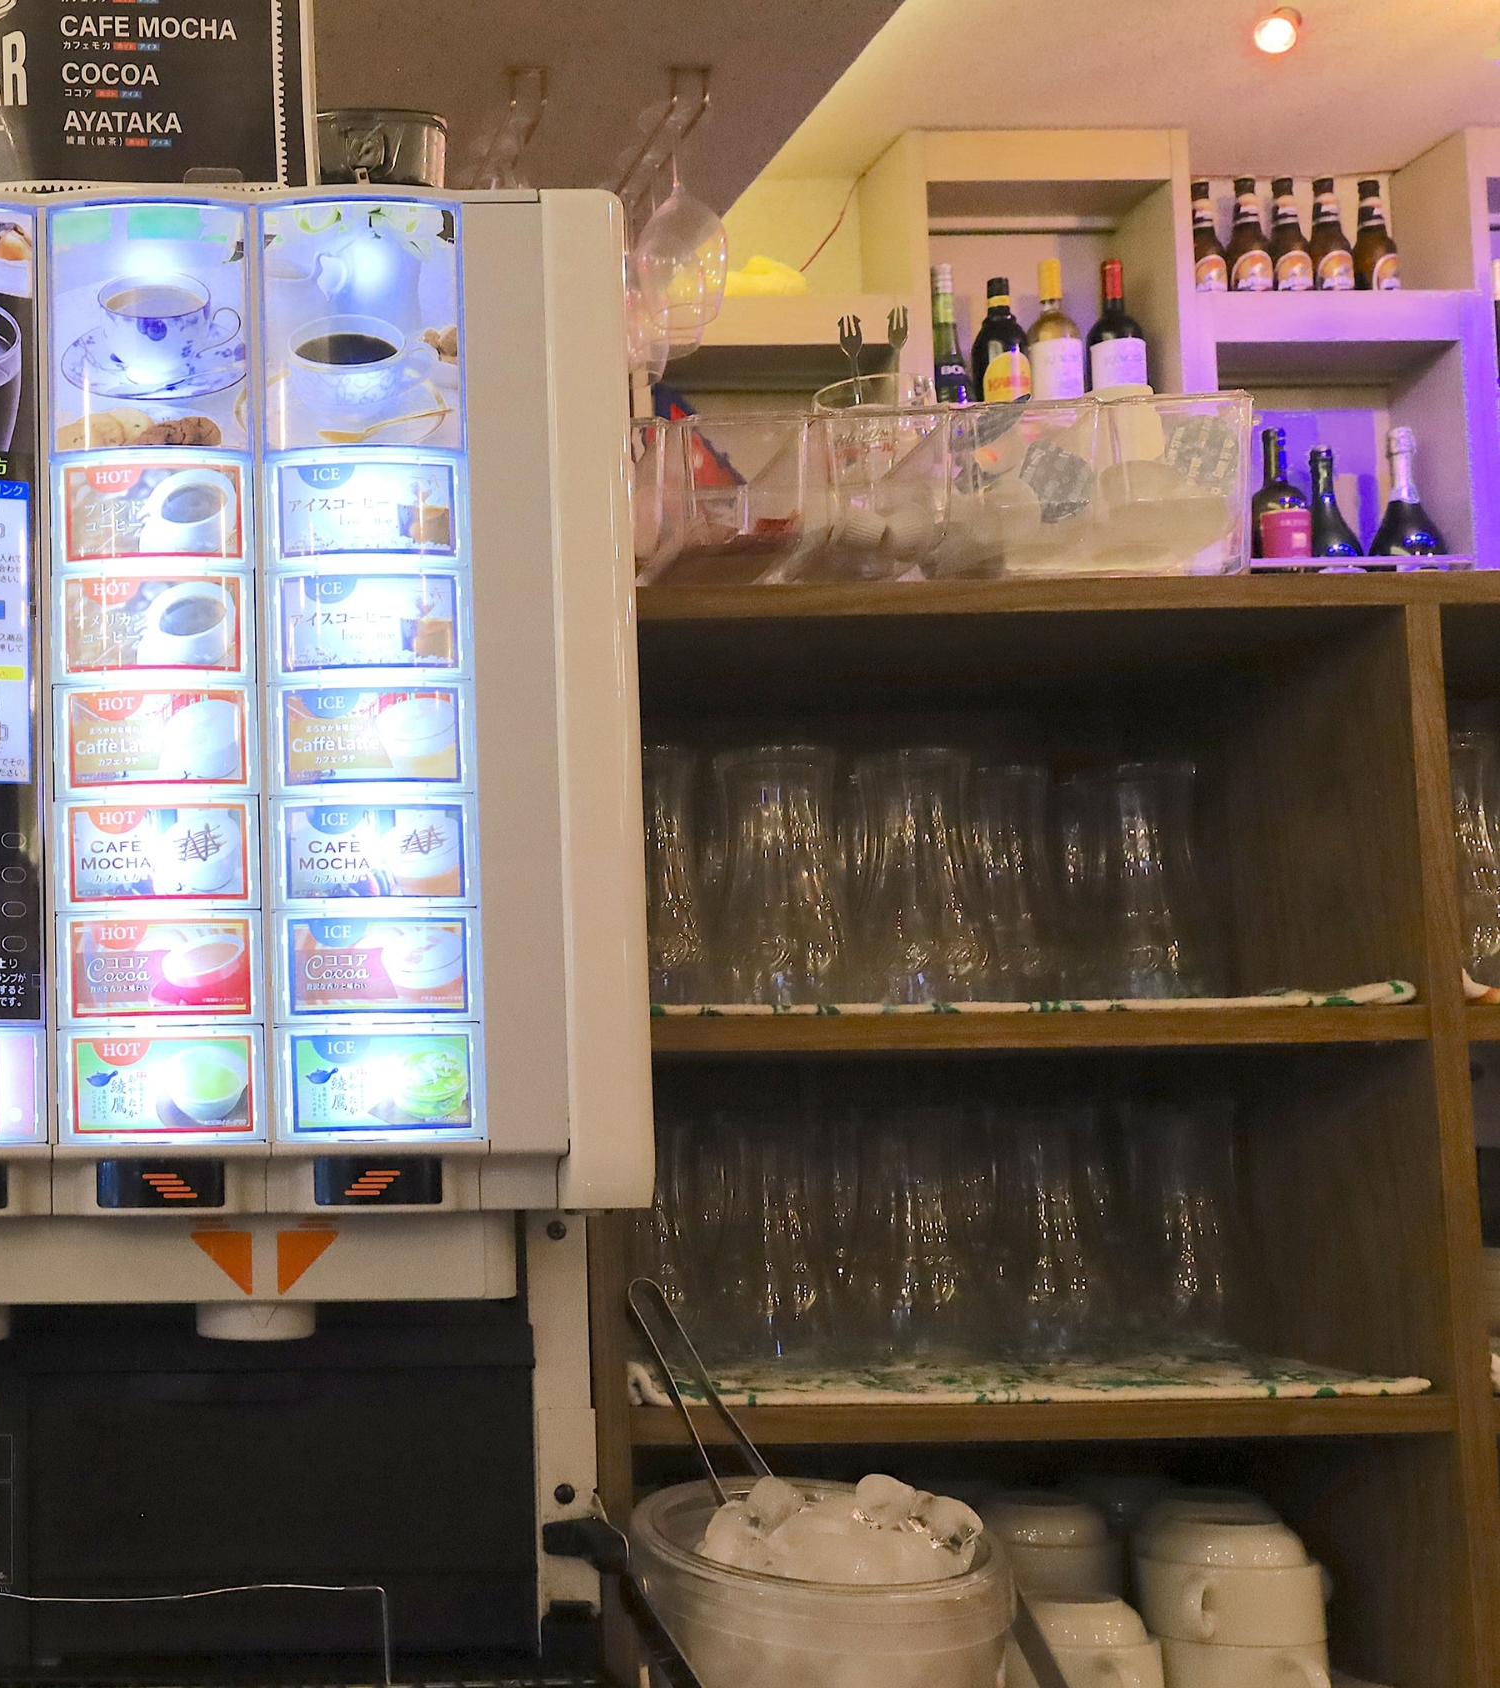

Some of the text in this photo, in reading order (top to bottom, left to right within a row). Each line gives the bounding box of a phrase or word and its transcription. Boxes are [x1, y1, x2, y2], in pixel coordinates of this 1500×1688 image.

[60, 15, 238, 40] CAFE MOCHA
[61, 62, 160, 86] COCOA
[63, 110, 182, 134] AYATAKA
[95, 469, 132, 485] HOT
[312, 468, 341, 482] ICE
[93, 581, 131, 596] HOT
[315, 581, 343, 596] ICE
[98, 697, 135, 711] HOT
[317, 696, 346, 710] ICE
[99, 811, 136, 825] HOT
[321, 812, 349, 827] ICE
[90, 840, 142, 854] CAFE
[308, 840, 361, 854] CAFE
[81, 857, 151, 870] MOCHA
[299, 857, 370, 870] MOCHA
[100, 926, 137, 941] HOT
[323, 925, 352, 939] ICE
[106, 956, 150, 968] ココア
[305, 954, 370, 981] Cocoa
[325, 954, 368, 967] ココア
[87, 957, 151, 983] Cocoa
[102, 1042, 141, 1057] HOT
[327, 1041, 356, 1054] ICE
